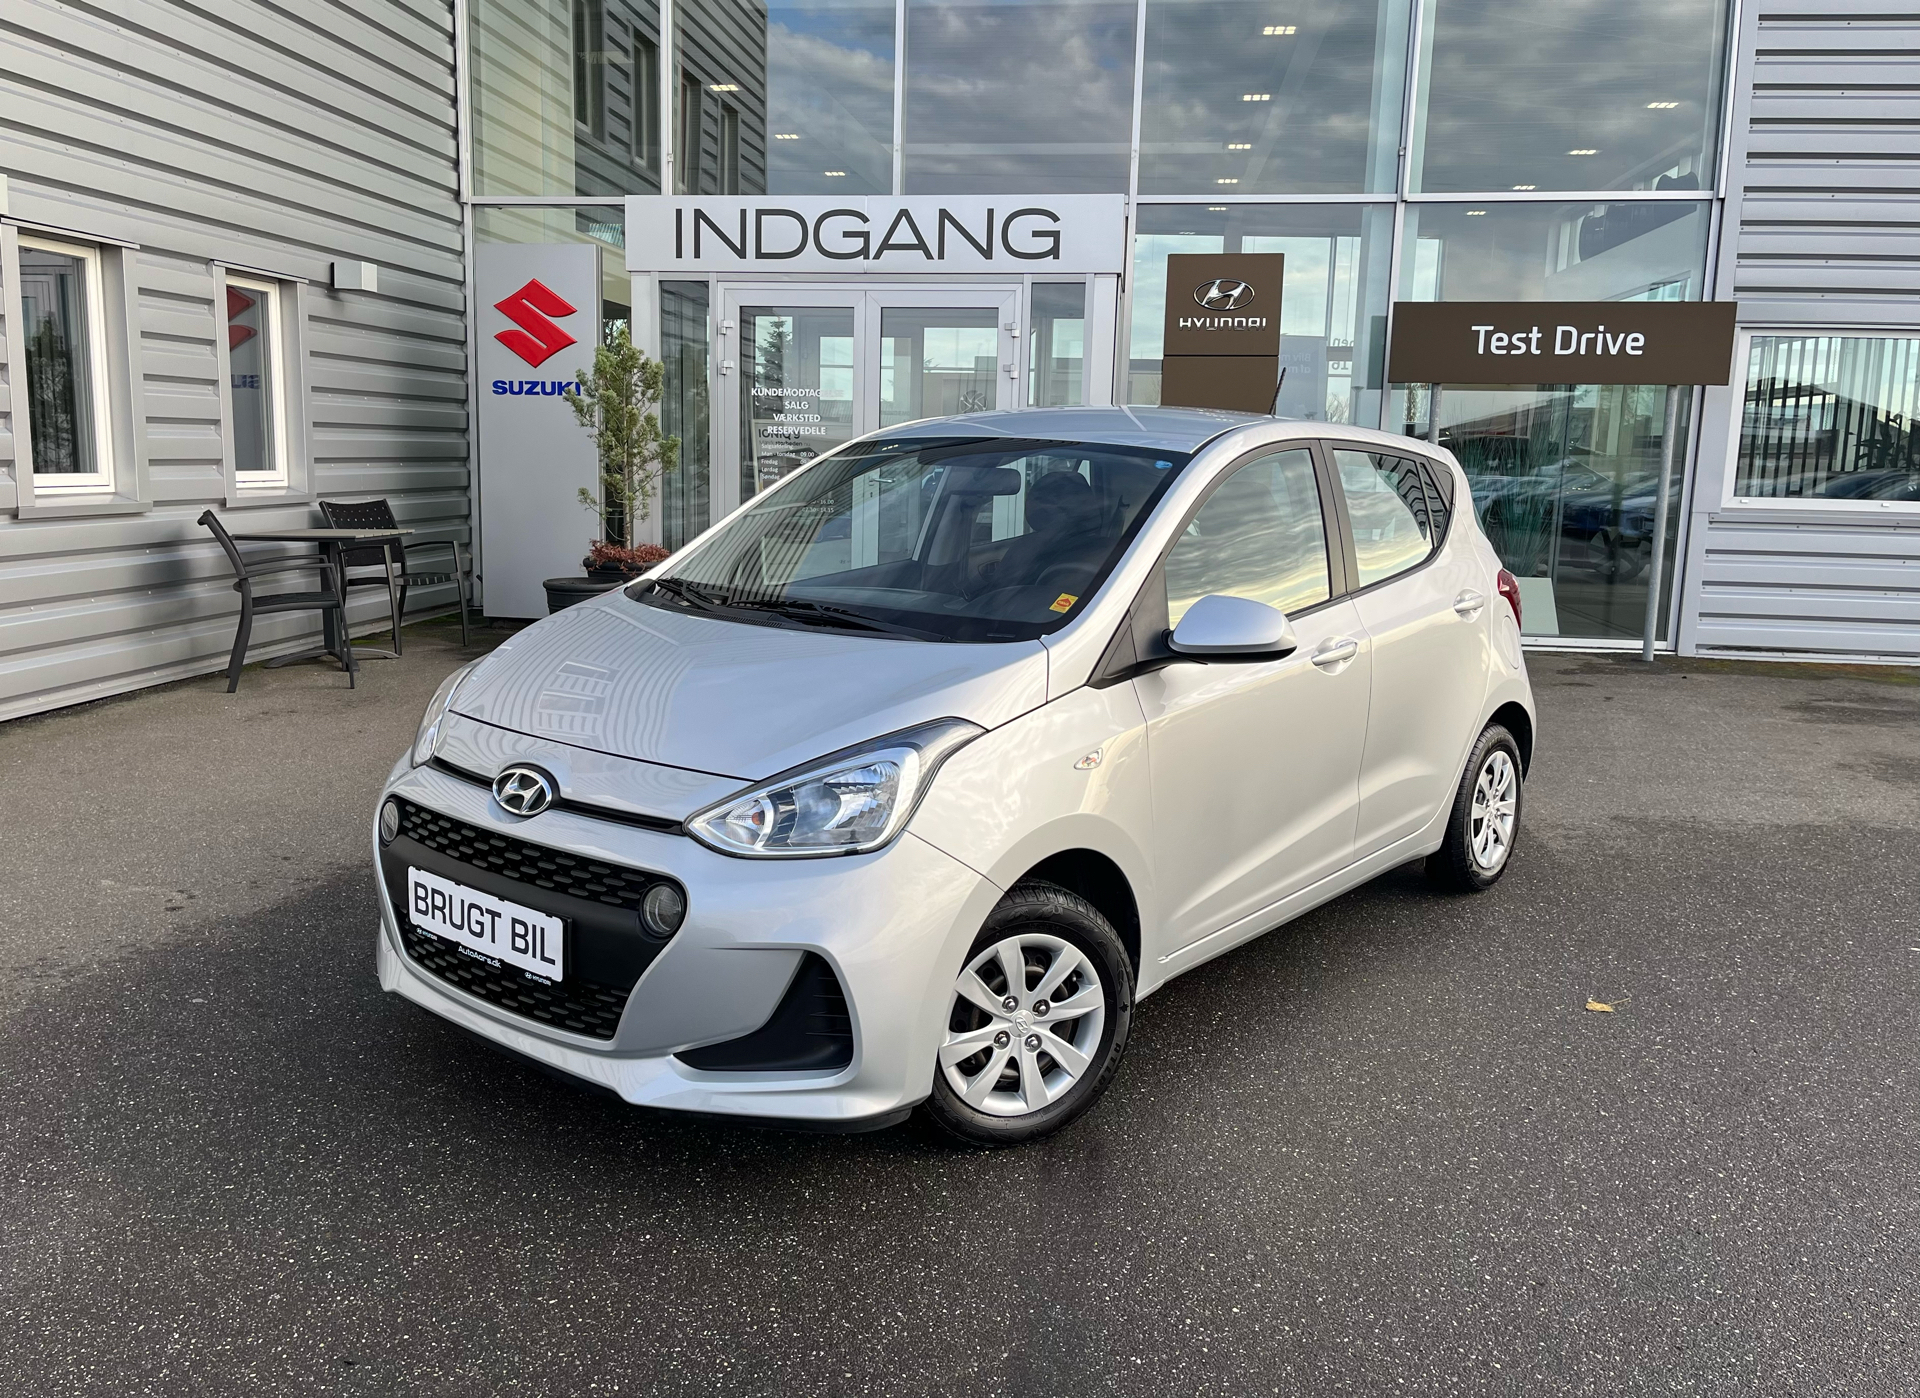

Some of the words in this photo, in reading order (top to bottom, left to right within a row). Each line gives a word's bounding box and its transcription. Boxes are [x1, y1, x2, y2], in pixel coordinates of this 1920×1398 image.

[675, 208, 1061, 260] INDGANG
[1179, 317, 1266, 331] HYUNDAI
[1471, 325, 1542, 355] Test
[1554, 325, 1645, 355] Drive
[492, 379, 581, 396] SUZUKI
[784, 401, 809, 410] SALG
[773, 413, 821, 422] VÆRKSTED
[767, 426, 826, 435] RESERVEDELE
[414, 881, 501, 944] BRUGT
[511, 917, 556, 966] BIL
